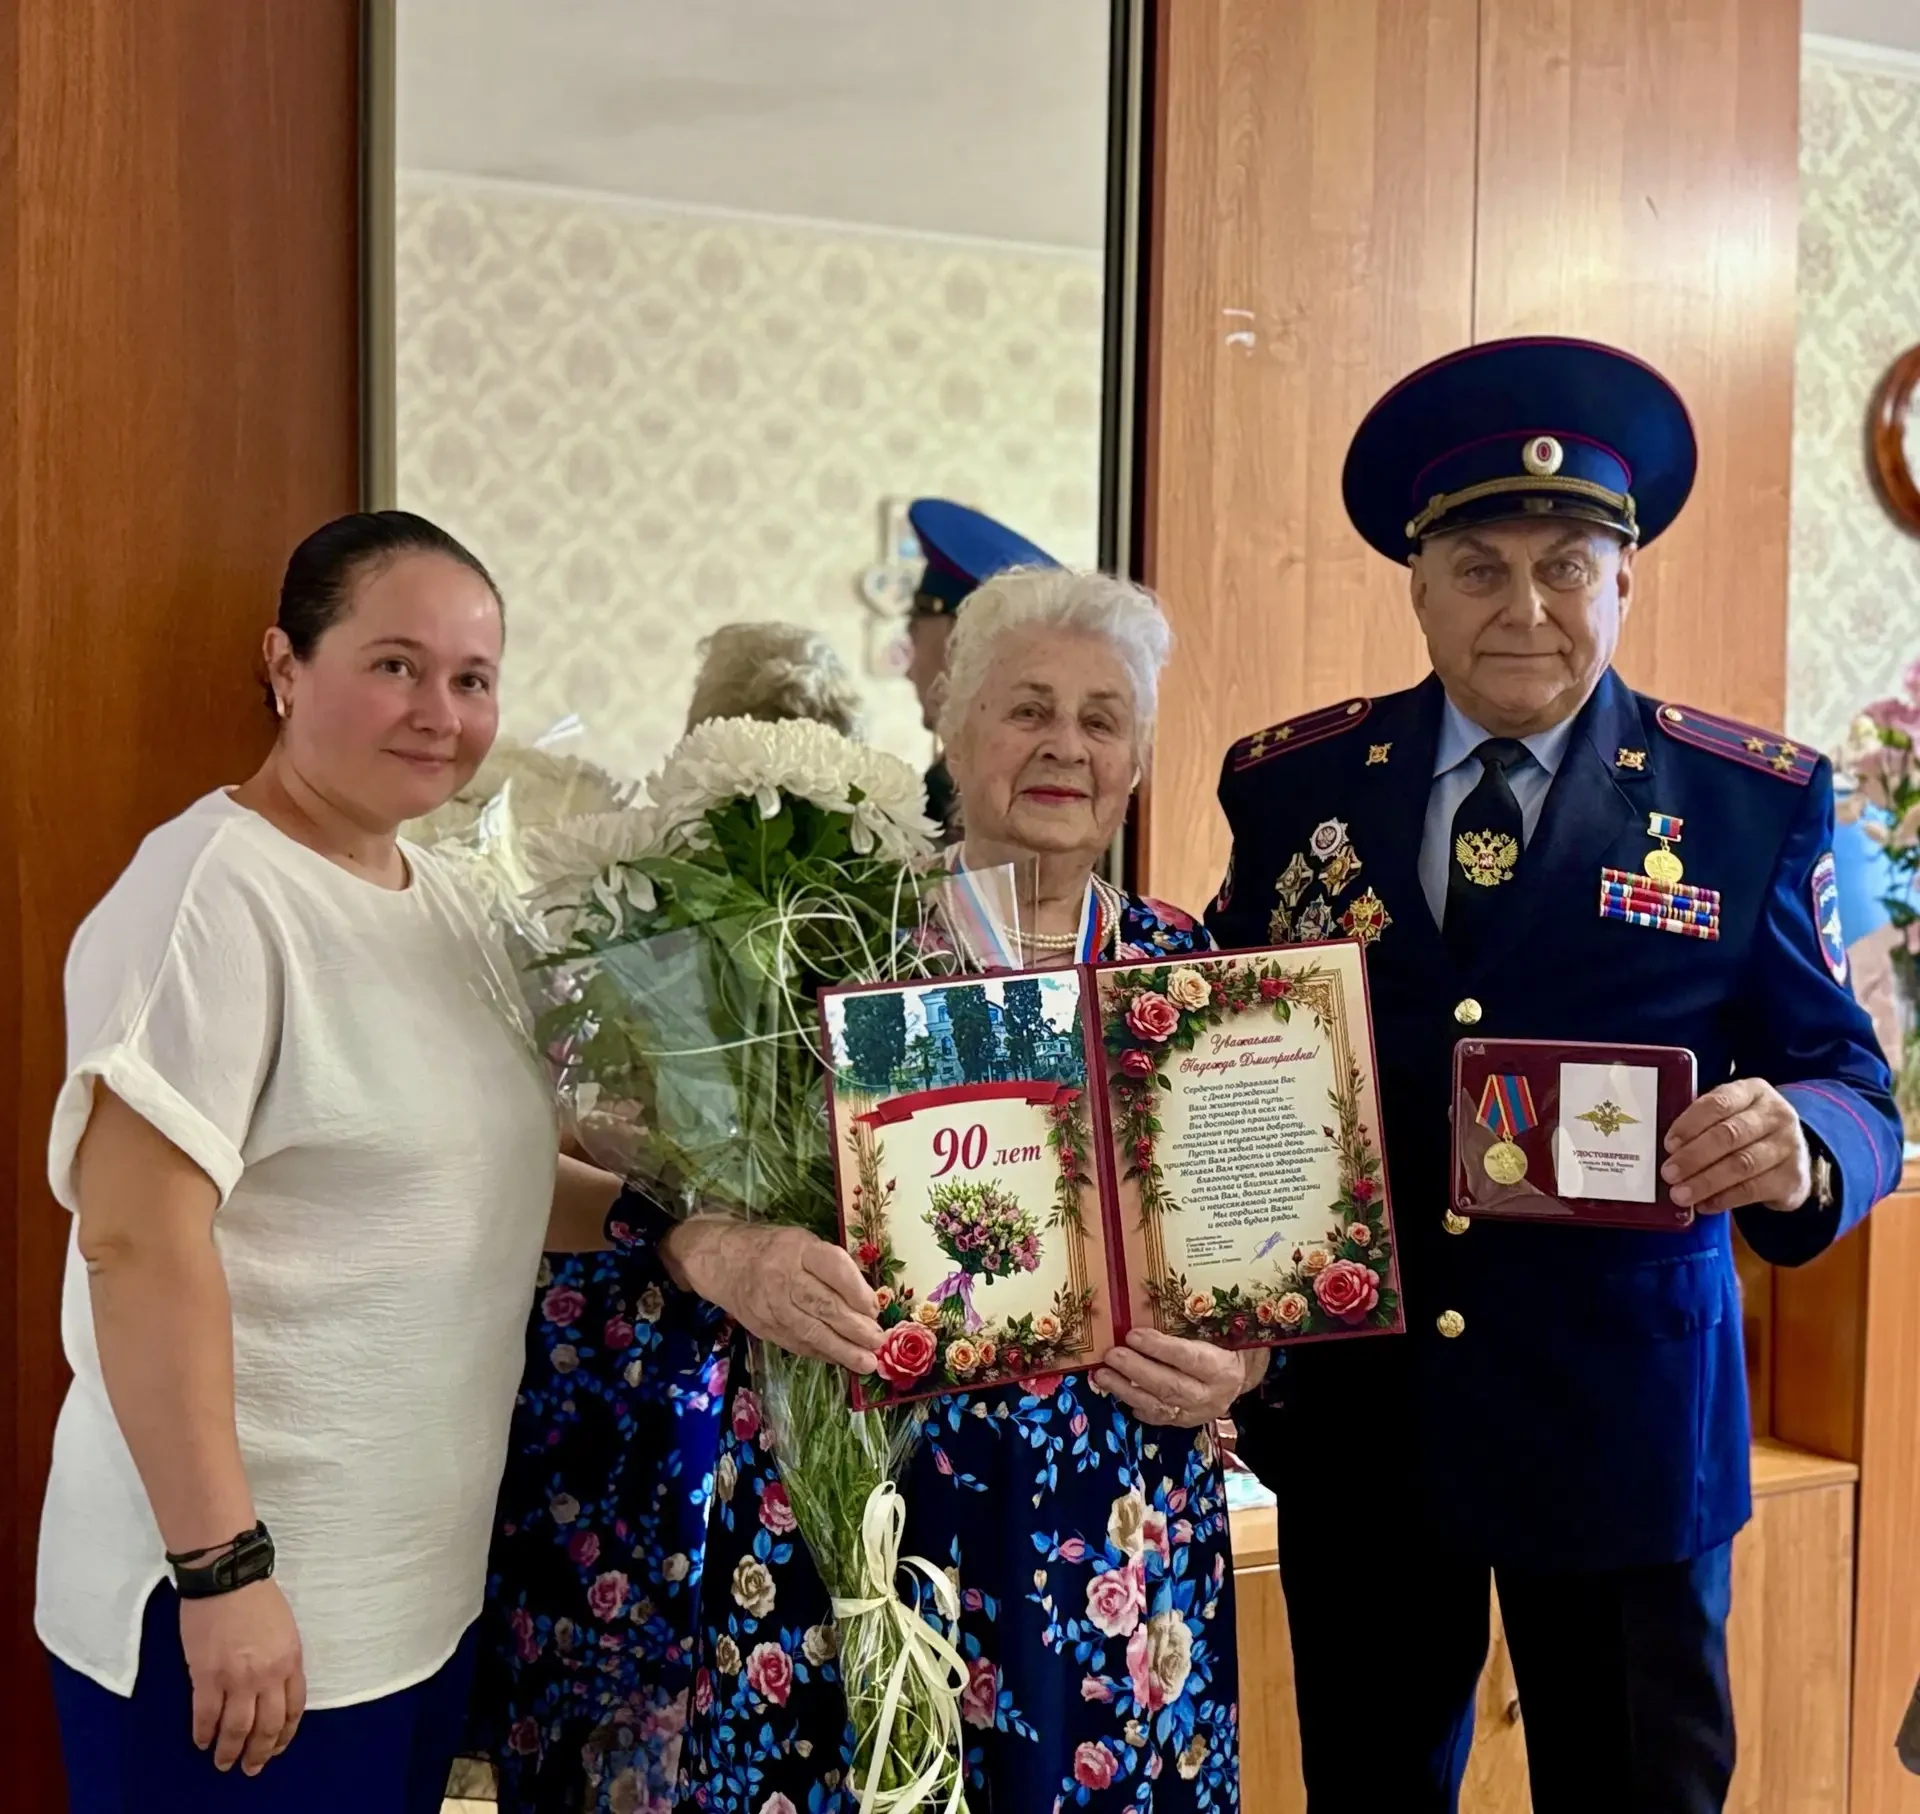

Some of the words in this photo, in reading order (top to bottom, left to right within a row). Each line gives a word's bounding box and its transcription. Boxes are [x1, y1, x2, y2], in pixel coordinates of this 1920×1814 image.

[1211, 1033, 1283, 1055] Уважаемая
[1180, 1057, 1237, 1078] Надежда
[1239, 1045, 1320, 1069] Дмитриевна!
[1183, 1085, 1223, 1095] Сердечно
[1225, 1077, 1279, 1090] поздравляем
[1280, 1076, 1296, 1084] Вас
[1232, 1086, 1279, 1099] рождения!
[1188, 1104, 1207, 1112] Ваш
[1209, 1098, 1260, 1110] жизненный
[1261, 1096, 1284, 1105] путь
[1190, 1113, 1206, 1121] это
[1208, 1110, 1240, 1120] пример
[1241, 1107, 1256, 1116] для
[1258, 1105, 1276, 1113] всех
[1189, 1122, 1202, 1130] Вы
[1204, 1119, 1245, 1129] достойно
[1247, 1115, 1280, 1125] прошли
[1223, 1128, 1239, 1136] при
[930, 1123, 988, 1178] 90
[992, 1144, 1042, 1167] лет
[1172, 1141, 1218, 1150] оптимизм
[1188, 1149, 1216, 1158] Пусть
[1217, 1144, 1253, 1154] каждый
[1255, 1141, 1283, 1150] новый
[1163, 1159, 1206, 1170] приносит
[1208, 1156, 1225, 1164] Вам
[1227, 1152, 1264, 1163] радость
[1180, 1168, 1214, 1177] Желаем
[1216, 1165, 1233, 1173] Вам
[1235, 1161, 1274, 1171] крепкого
[1259, 1167, 1302, 1177] внимания
[1181, 1195, 1219, 1204] Счастья
[1242, 1188, 1271, 1197] долгих
[1273, 1186, 1290, 1194] лет
[1292, 1183, 1320, 1192] жизни
[1206, 1183, 1235, 1192] коллег
[1243, 1179, 1278, 1188] близких
[1207, 1196, 1266, 1210] неиссякаемой
[1213, 1211, 1227, 1219] Мы
[1229, 1207, 1269, 1217] гордимся
[1271, 1204, 1293, 1213] Вами
[1215, 1219, 1242, 1229] всегда
[1244, 1216, 1269, 1226] будем
